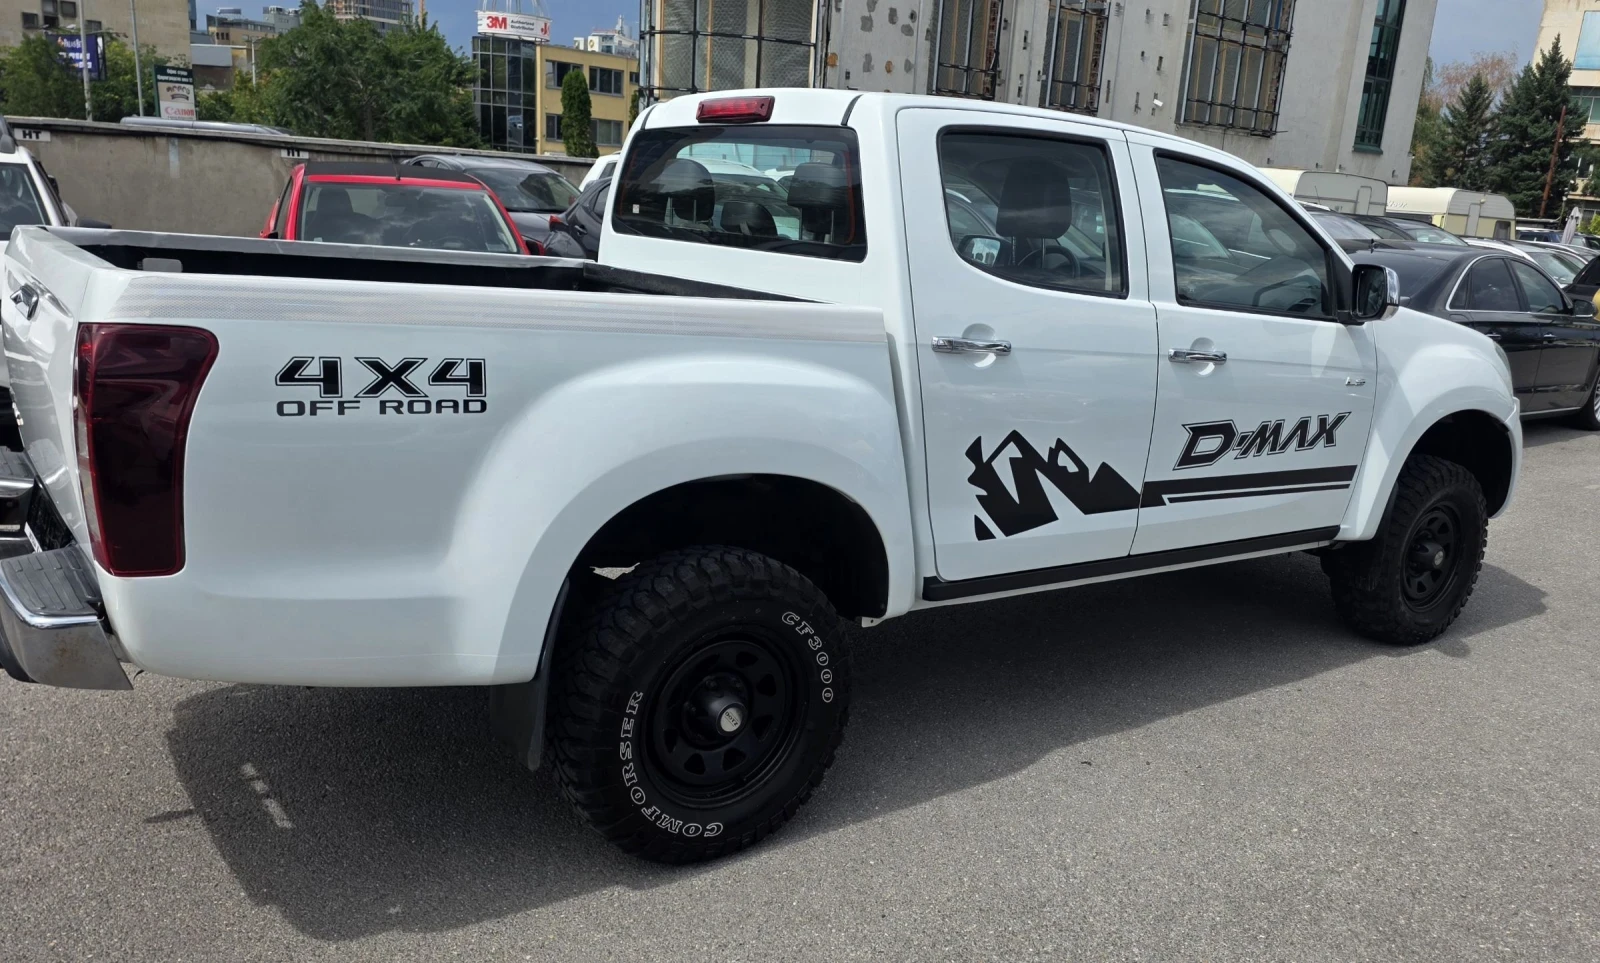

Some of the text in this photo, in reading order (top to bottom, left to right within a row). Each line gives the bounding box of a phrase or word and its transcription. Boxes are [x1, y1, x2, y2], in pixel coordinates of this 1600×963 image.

[486, 15, 507, 30] 3M
[165, 106, 195, 116] Canon
[275, 356, 487, 398] 4X4
[276, 399, 488, 417] OFF ROAD
[1172, 411, 1352, 471] D-MAX
[781, 611, 834, 703] CF3000
[619, 691, 723, 837] COMFORSER
